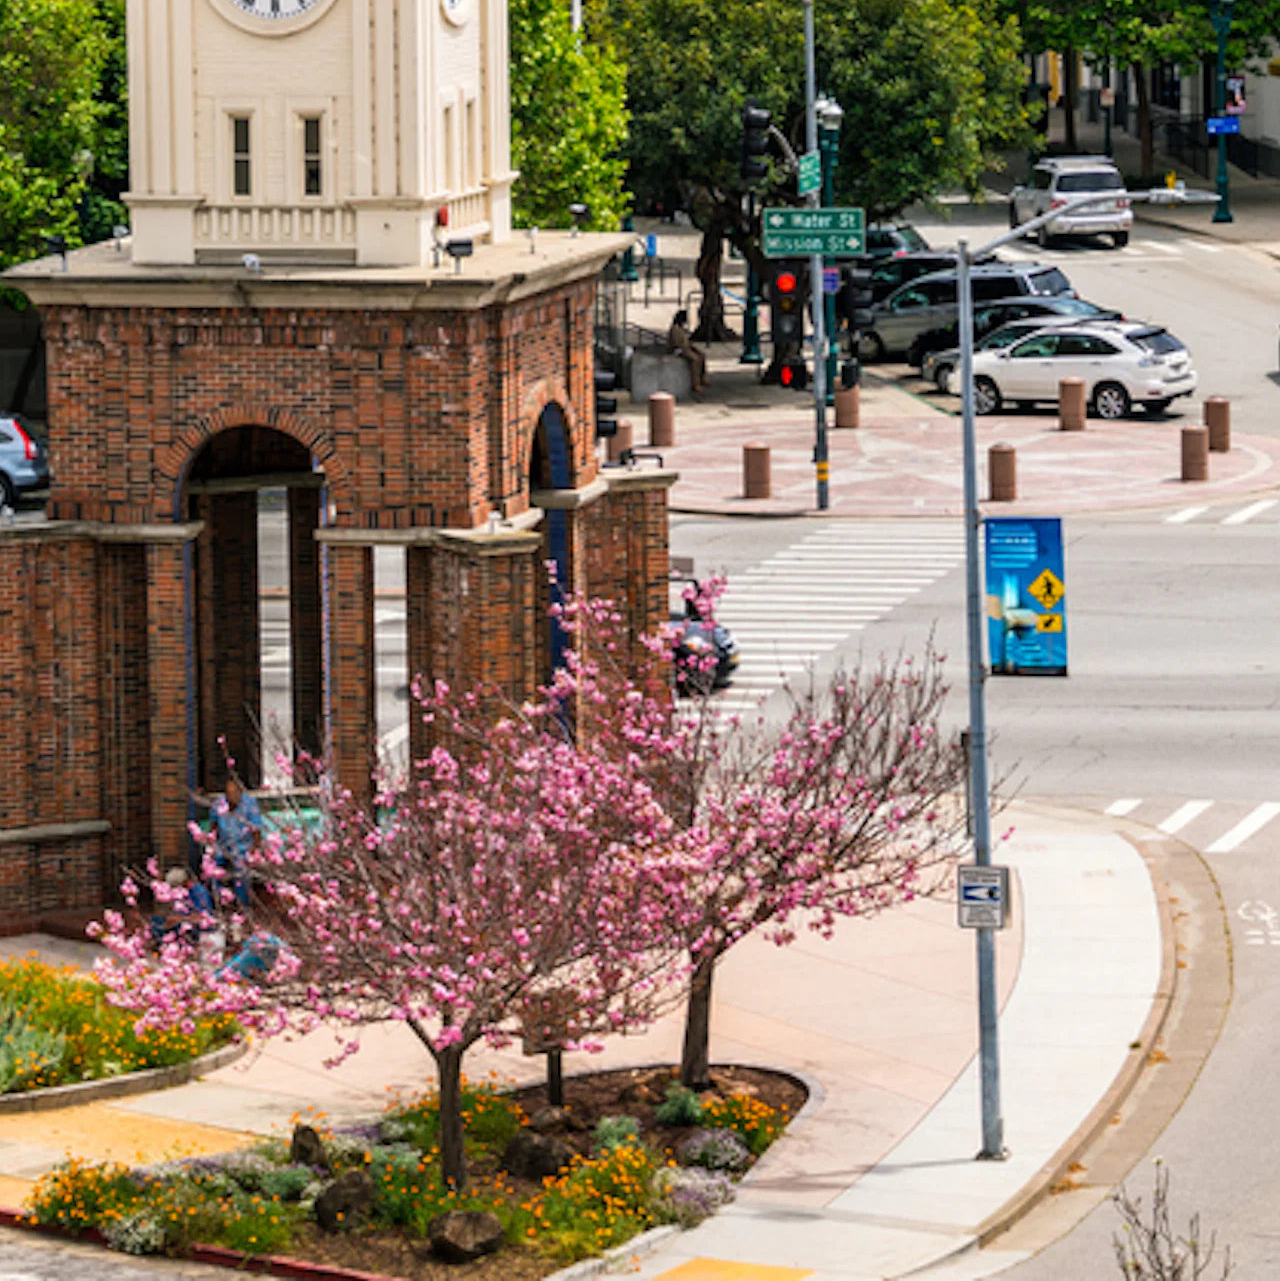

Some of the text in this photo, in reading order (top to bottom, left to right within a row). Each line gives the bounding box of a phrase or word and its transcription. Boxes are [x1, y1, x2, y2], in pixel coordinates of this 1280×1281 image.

[790, 212, 856, 229] Water St
[768, 234, 846, 252] Mission St
